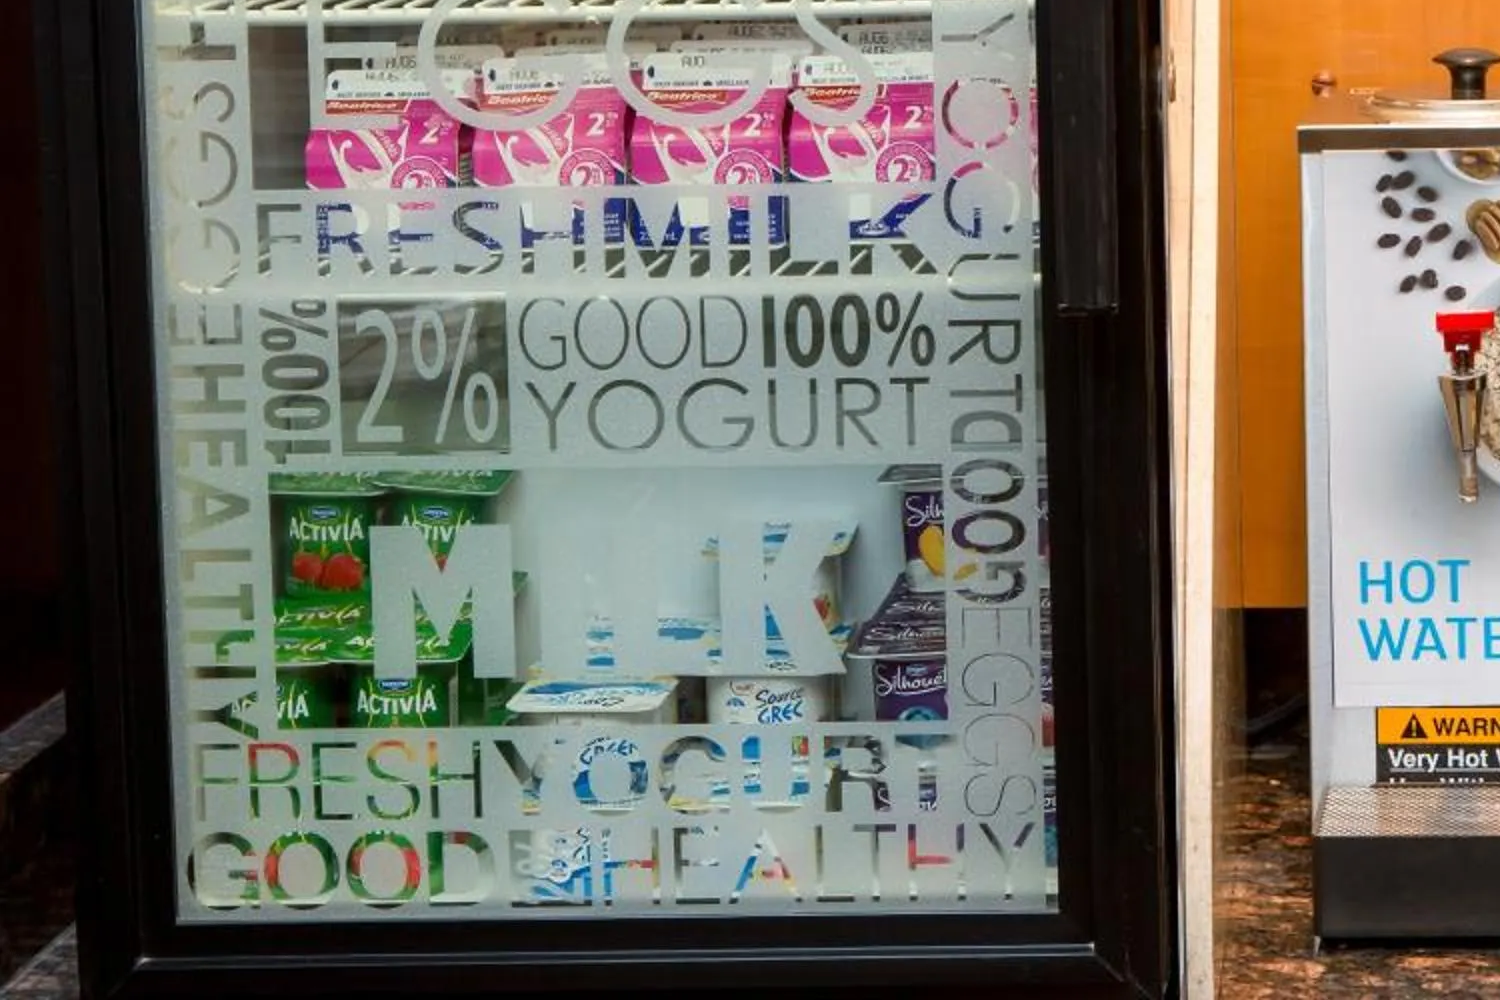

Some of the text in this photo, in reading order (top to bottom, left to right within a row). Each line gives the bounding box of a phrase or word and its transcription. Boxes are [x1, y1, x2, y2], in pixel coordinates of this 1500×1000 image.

[256, 193, 939, 279] FRESH MILK
[518, 291, 937, 371] GOOD 100%
[258, 297, 331, 465] 100%
[355, 308, 501, 447] 2%
[525, 377, 932, 452] YOGURT
[289, 515, 364, 542] ACTIVIA
[951, 411, 1029, 605] GOOD
[1359, 558, 1471, 605] HOT
[356, 686, 438, 715] ACTIVIA
[962, 607, 1038, 817] EGGS
[193, 734, 957, 821] FRESH YOGURT
[1388, 748, 1440, 772] Very
[1446, 749, 1489, 768] Hot
[187, 830, 497, 910] GOOD
[603, 822, 1036, 906] HEALTHY
